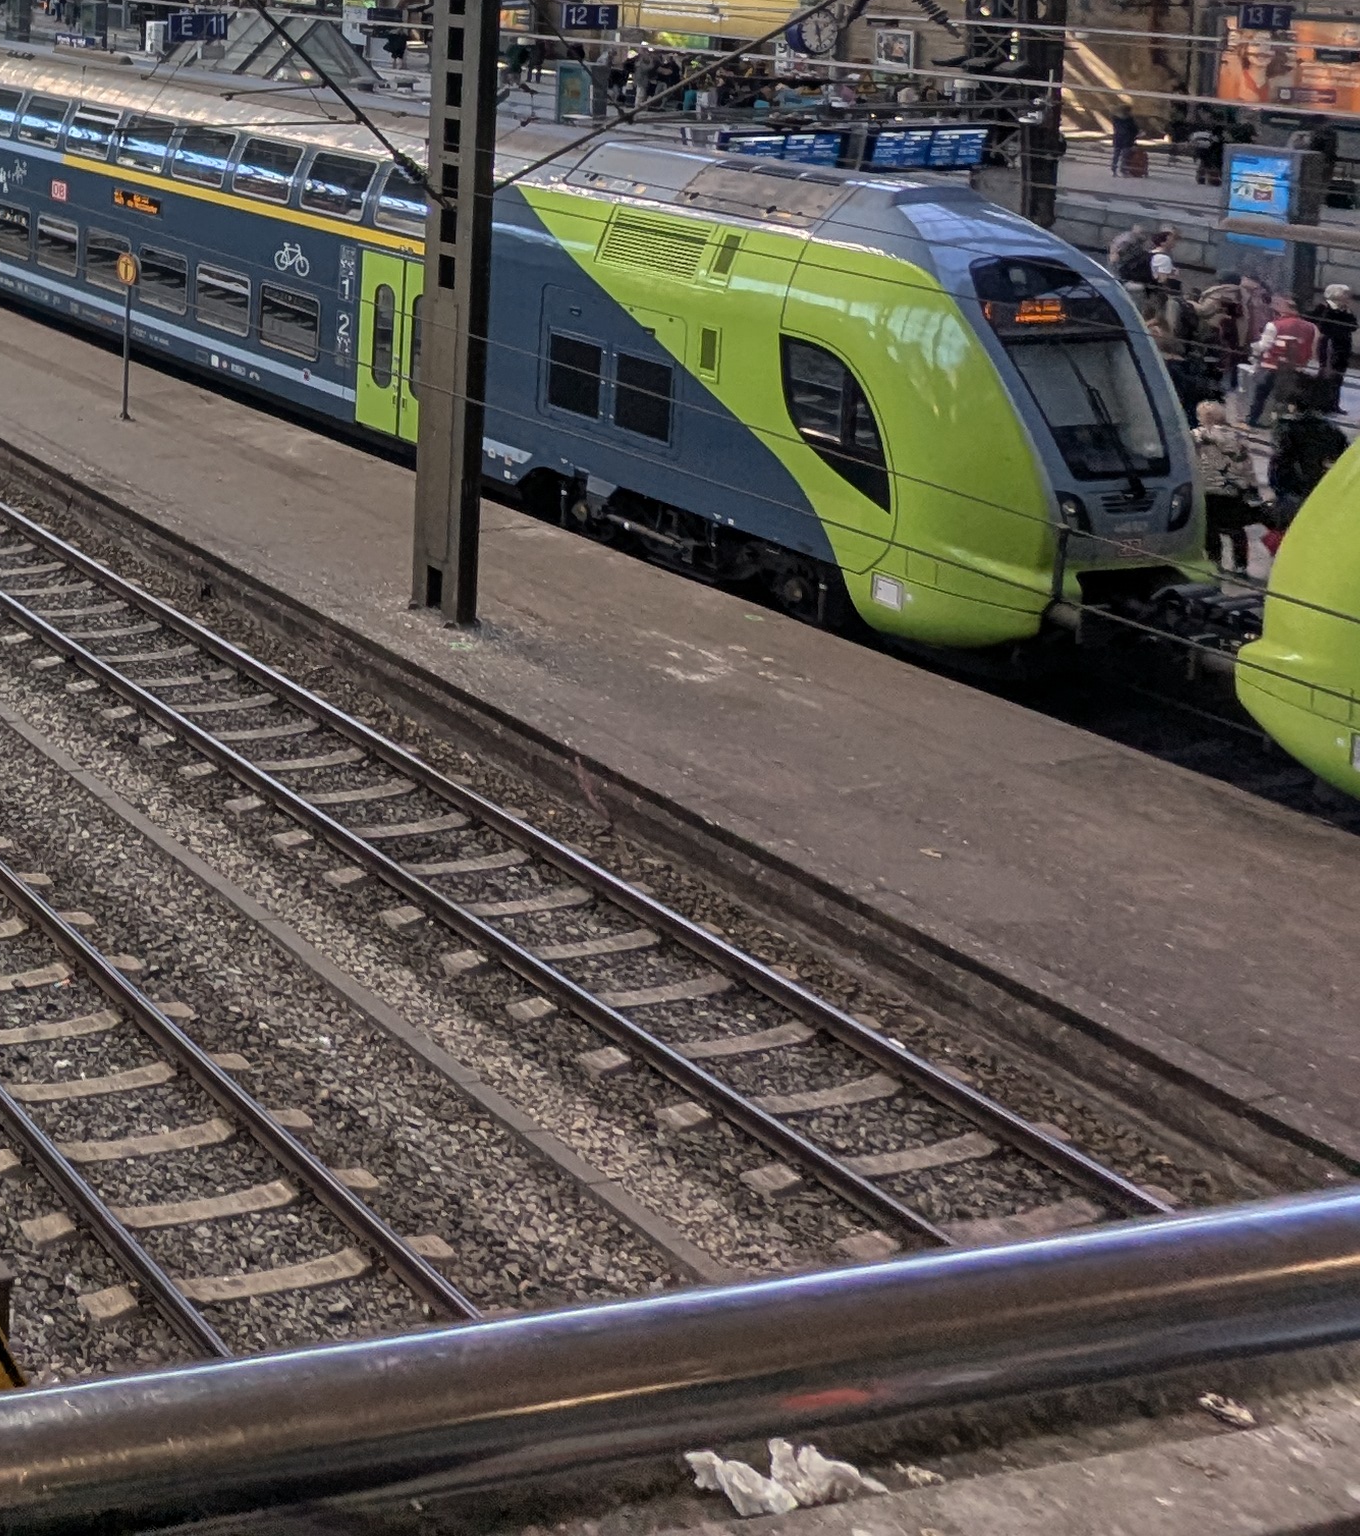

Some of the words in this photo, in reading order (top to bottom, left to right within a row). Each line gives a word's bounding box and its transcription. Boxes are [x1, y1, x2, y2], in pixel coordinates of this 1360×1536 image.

[181, 16, 193, 35] E
[210, 15, 225, 35] 11
[569, 6, 588, 24] 12
[598, 6, 610, 24] E
[1247, 6, 1263, 24] 13
[1272, 7, 1284, 26] E
[341, 278, 350, 300] 1
[338, 313, 350, 336] 2
